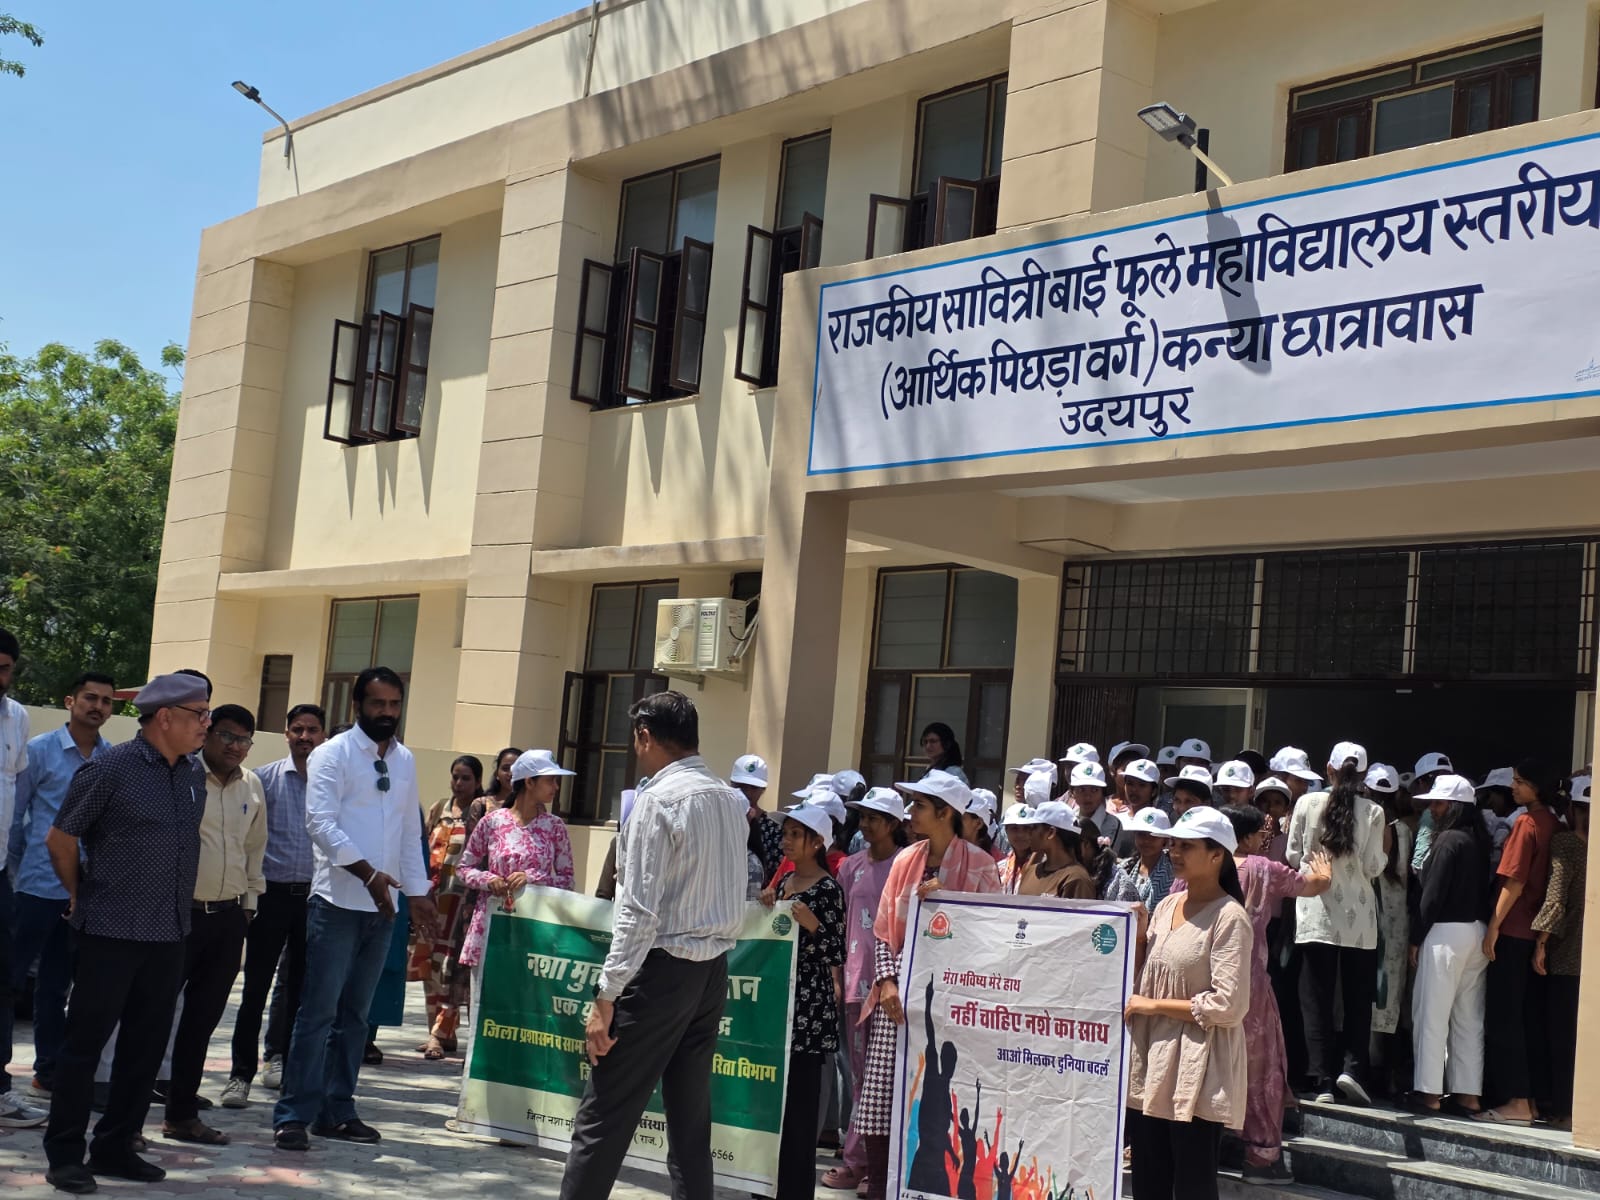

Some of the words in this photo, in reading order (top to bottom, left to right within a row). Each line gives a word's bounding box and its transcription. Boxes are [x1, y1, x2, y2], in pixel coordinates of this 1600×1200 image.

[828, 285, 941, 353] राजकीय
[942, 265, 1050, 333] सावित्री
[1115, 233, 1185, 323] फूले
[1187, 212, 1439, 297] महाविद्यालय
[1444, 161, 1600, 251] स्तरीय
[881, 348, 986, 419] (आर्थिक
[987, 338, 1086, 398] पिछड़ा
[1163, 313, 1279, 372] कन्या
[1282, 283, 1484, 357] छात्रावास
[1060, 386, 1194, 438] उदयपुर
[527, 953, 570, 981] नशा
[943, 967, 959, 985] मेरा
[959, 970, 987, 988] भविष्य
[989, 972, 1002, 990] मेरे
[1003, 977, 1021, 993] हाथ
[552, 996, 582, 1016] एक
[482, 1019, 519, 1042] जिला
[519, 1028, 554, 1049] प्रशासन
[950, 1000, 978, 1027] नहीं
[979, 1004, 1021, 1033] चाहिए
[1025, 1010, 1051, 1037] नशे
[1053, 1017, 1076, 1040] का
[1078, 1020, 1110, 1045] साथ
[737, 1057, 777, 1082] विभाग
[996, 1047, 1022, 1065] आओ
[1022, 1048, 1057, 1068] मिलकर
[1057, 1054, 1086, 1075] दुनिया
[1087, 1059, 1110, 1077] बदलें
[711, 1148, 734, 1161] 6566
